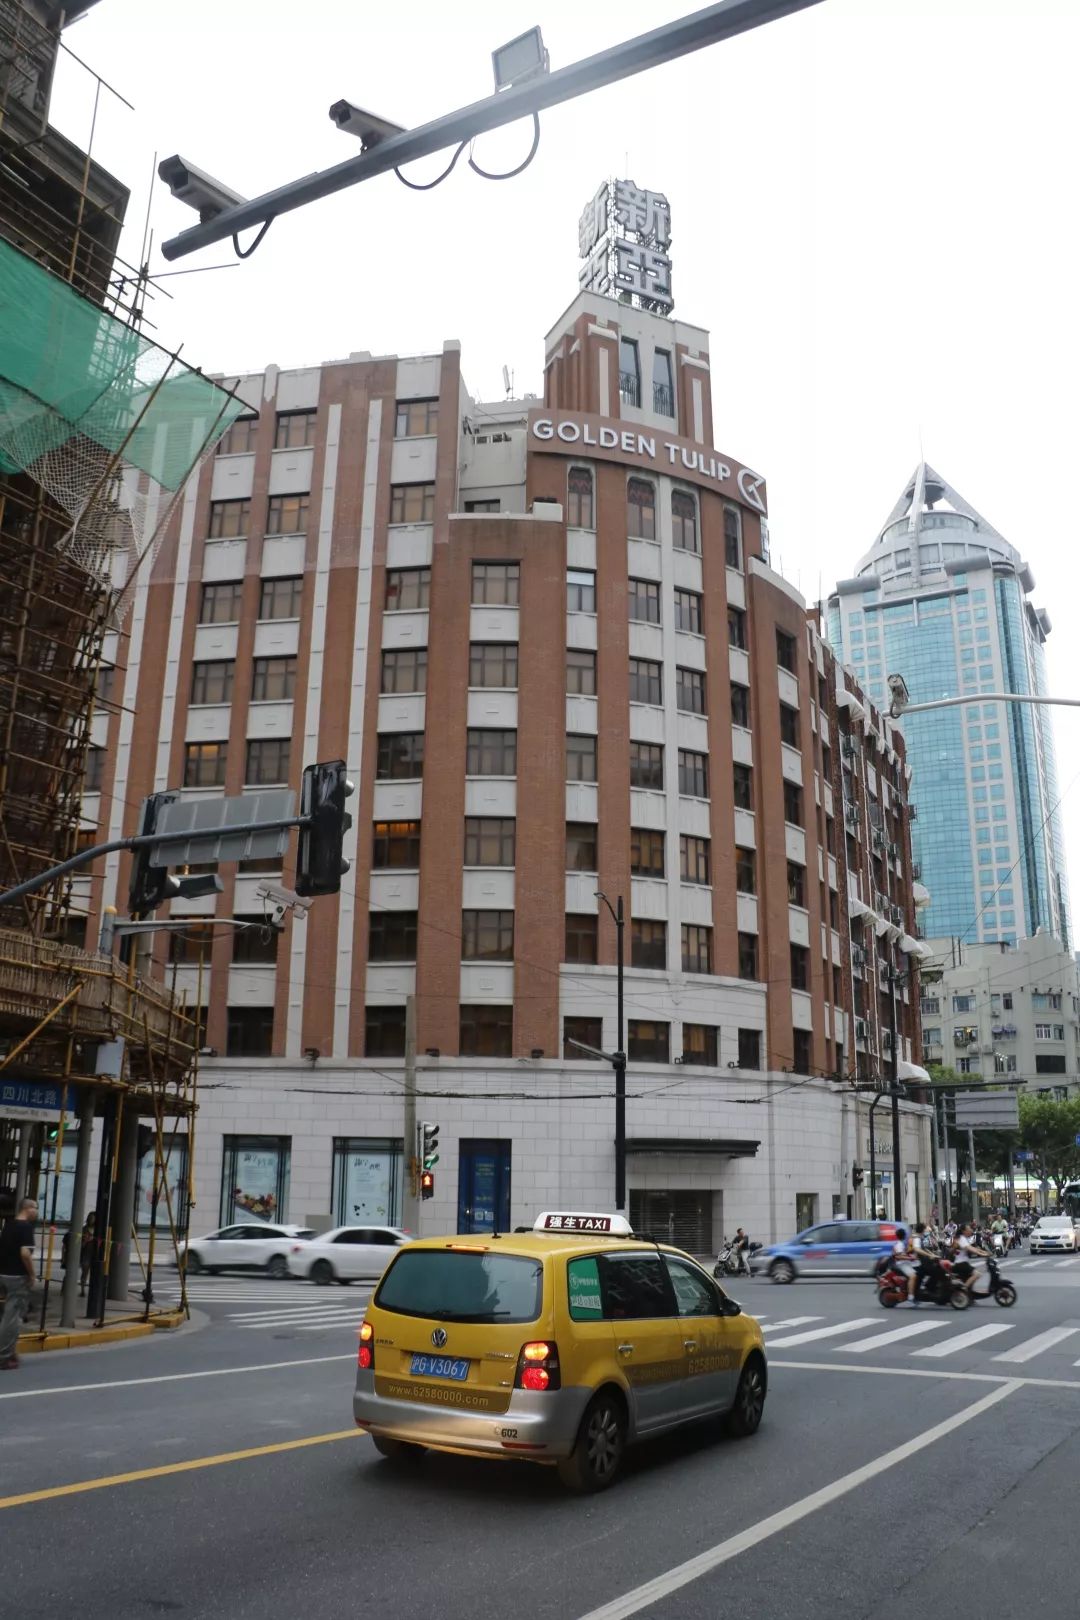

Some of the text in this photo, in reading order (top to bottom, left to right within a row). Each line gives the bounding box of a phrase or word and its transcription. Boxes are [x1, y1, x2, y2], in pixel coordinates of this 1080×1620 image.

[532, 419, 731, 481] GOLDEN TULIP
[2, 1085, 57, 1105] 四川北路
[388, 1383, 489, 1407] www.62580000.com
[501, 1428, 518, 1439] 602
